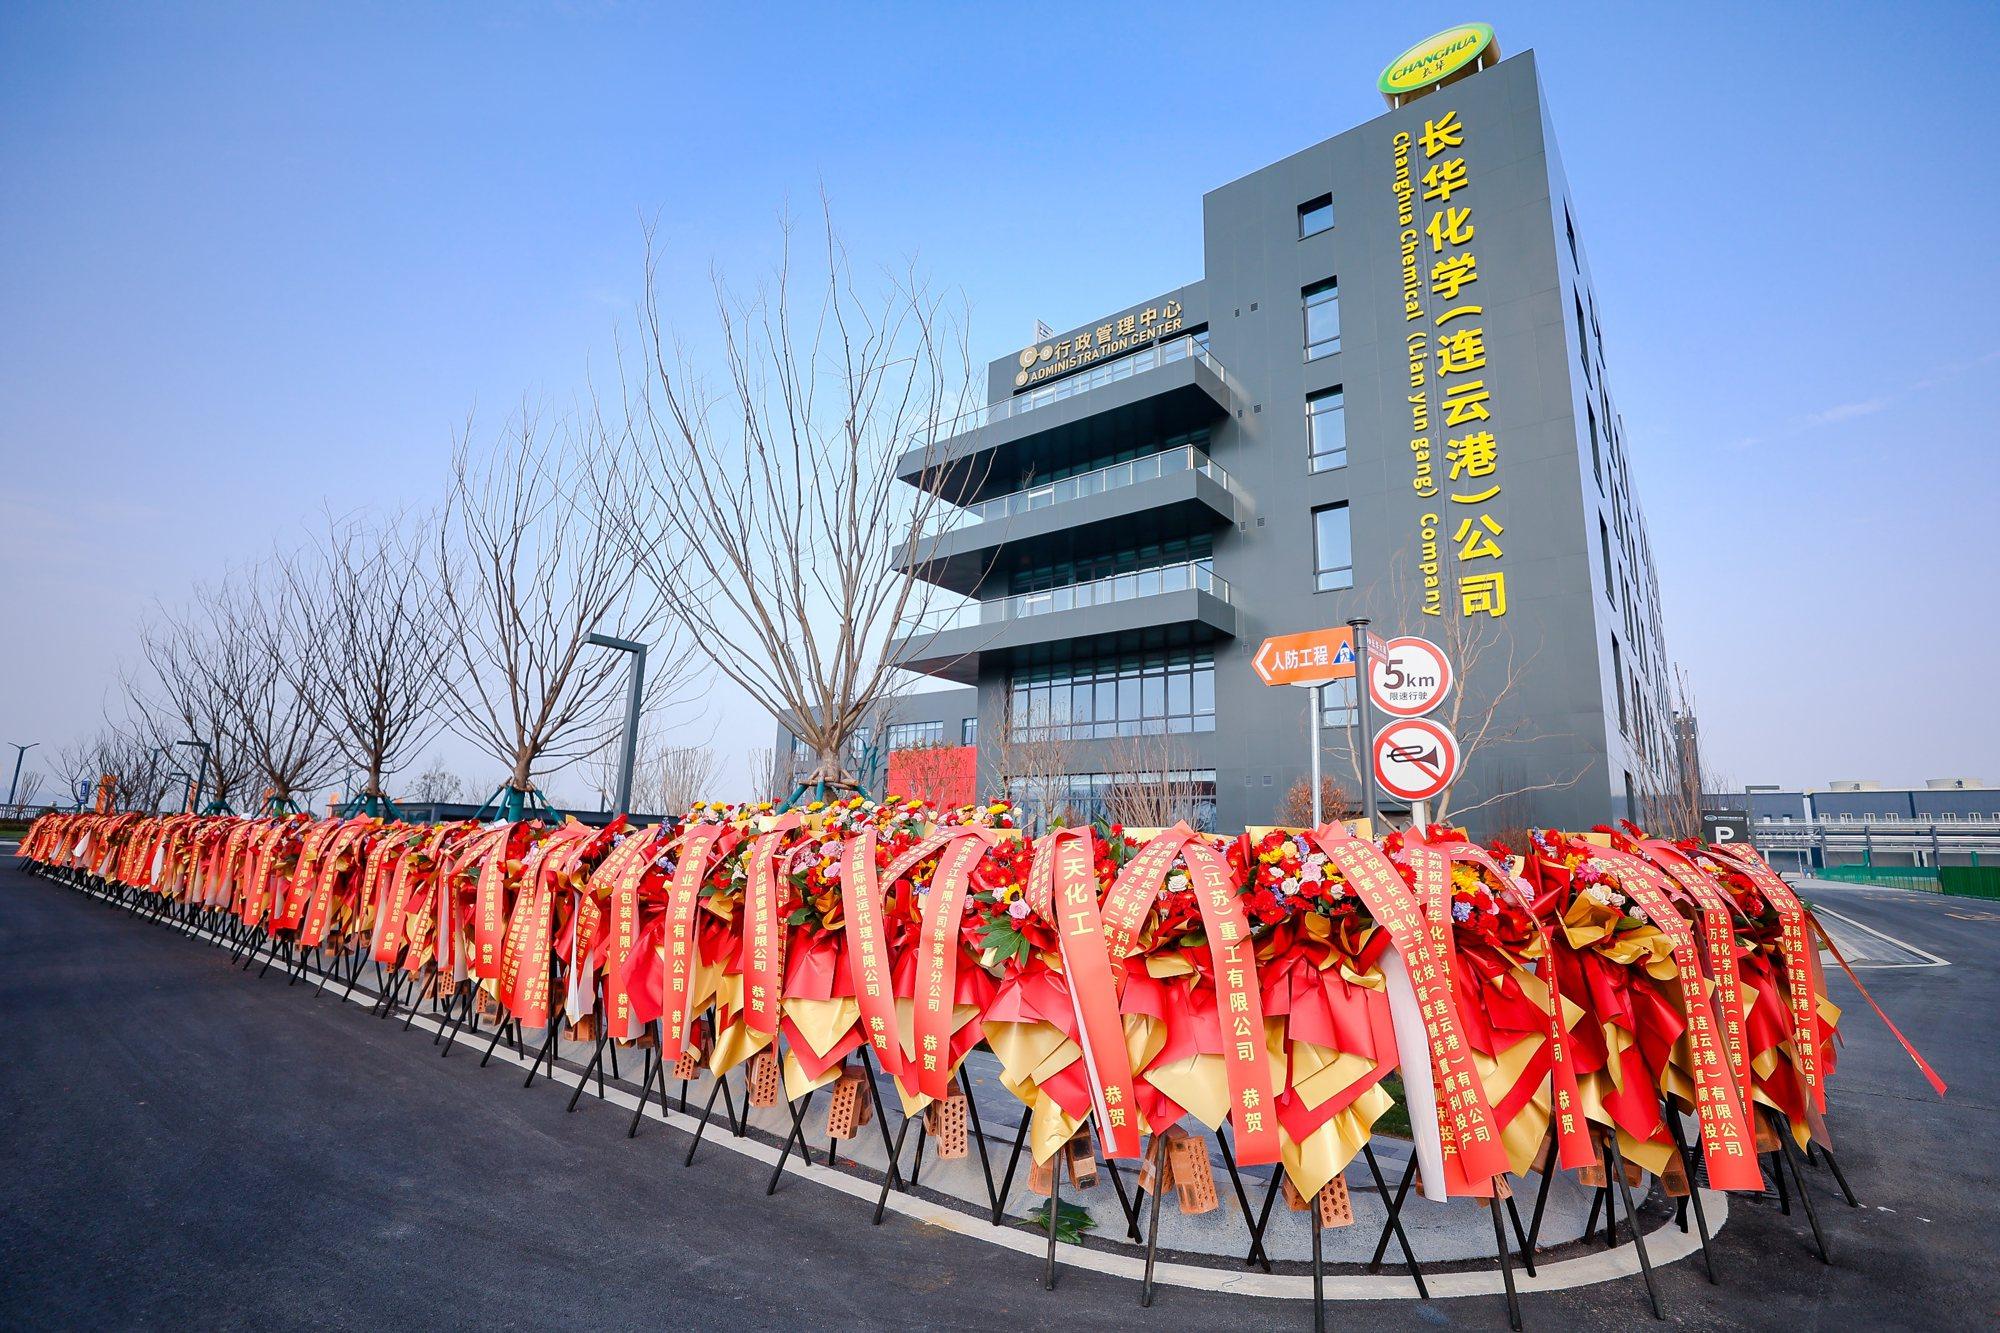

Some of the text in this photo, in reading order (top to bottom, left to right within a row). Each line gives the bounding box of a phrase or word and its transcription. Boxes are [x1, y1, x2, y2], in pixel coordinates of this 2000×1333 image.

[1392, 35, 1477, 80] CHANGHUA
[1055, 301, 1182, 360] 行政管理中心
[1031, 318, 1182, 382] ADMINISTRATION CENTER
[1419, 111, 1506, 617] 长华化学（连云港）公司
[1392, 131, 1441, 616] Changhua Chemical (Lian yun gang) Company
[1271, 645, 1328, 671] 人防工程
[1389, 691, 1427, 700] 限速行驶
[1715, 826, 1735, 844] P
[482, 943, 493, 964] 恭贺
[752, 985, 765, 1012] 恭贺
[1062, 839, 1126, 1127] 天天化工 恭贺
[617, 993, 629, 1020] 恭贺
[671, 1010, 682, 1039] 恭贺
[870, 1016, 887, 1050] 恭贺
[923, 1035, 937, 1072] 恭贺
[1242, 1088, 1263, 1133] 恭贺
[1558, 1089, 1576, 1135] 恭贺
